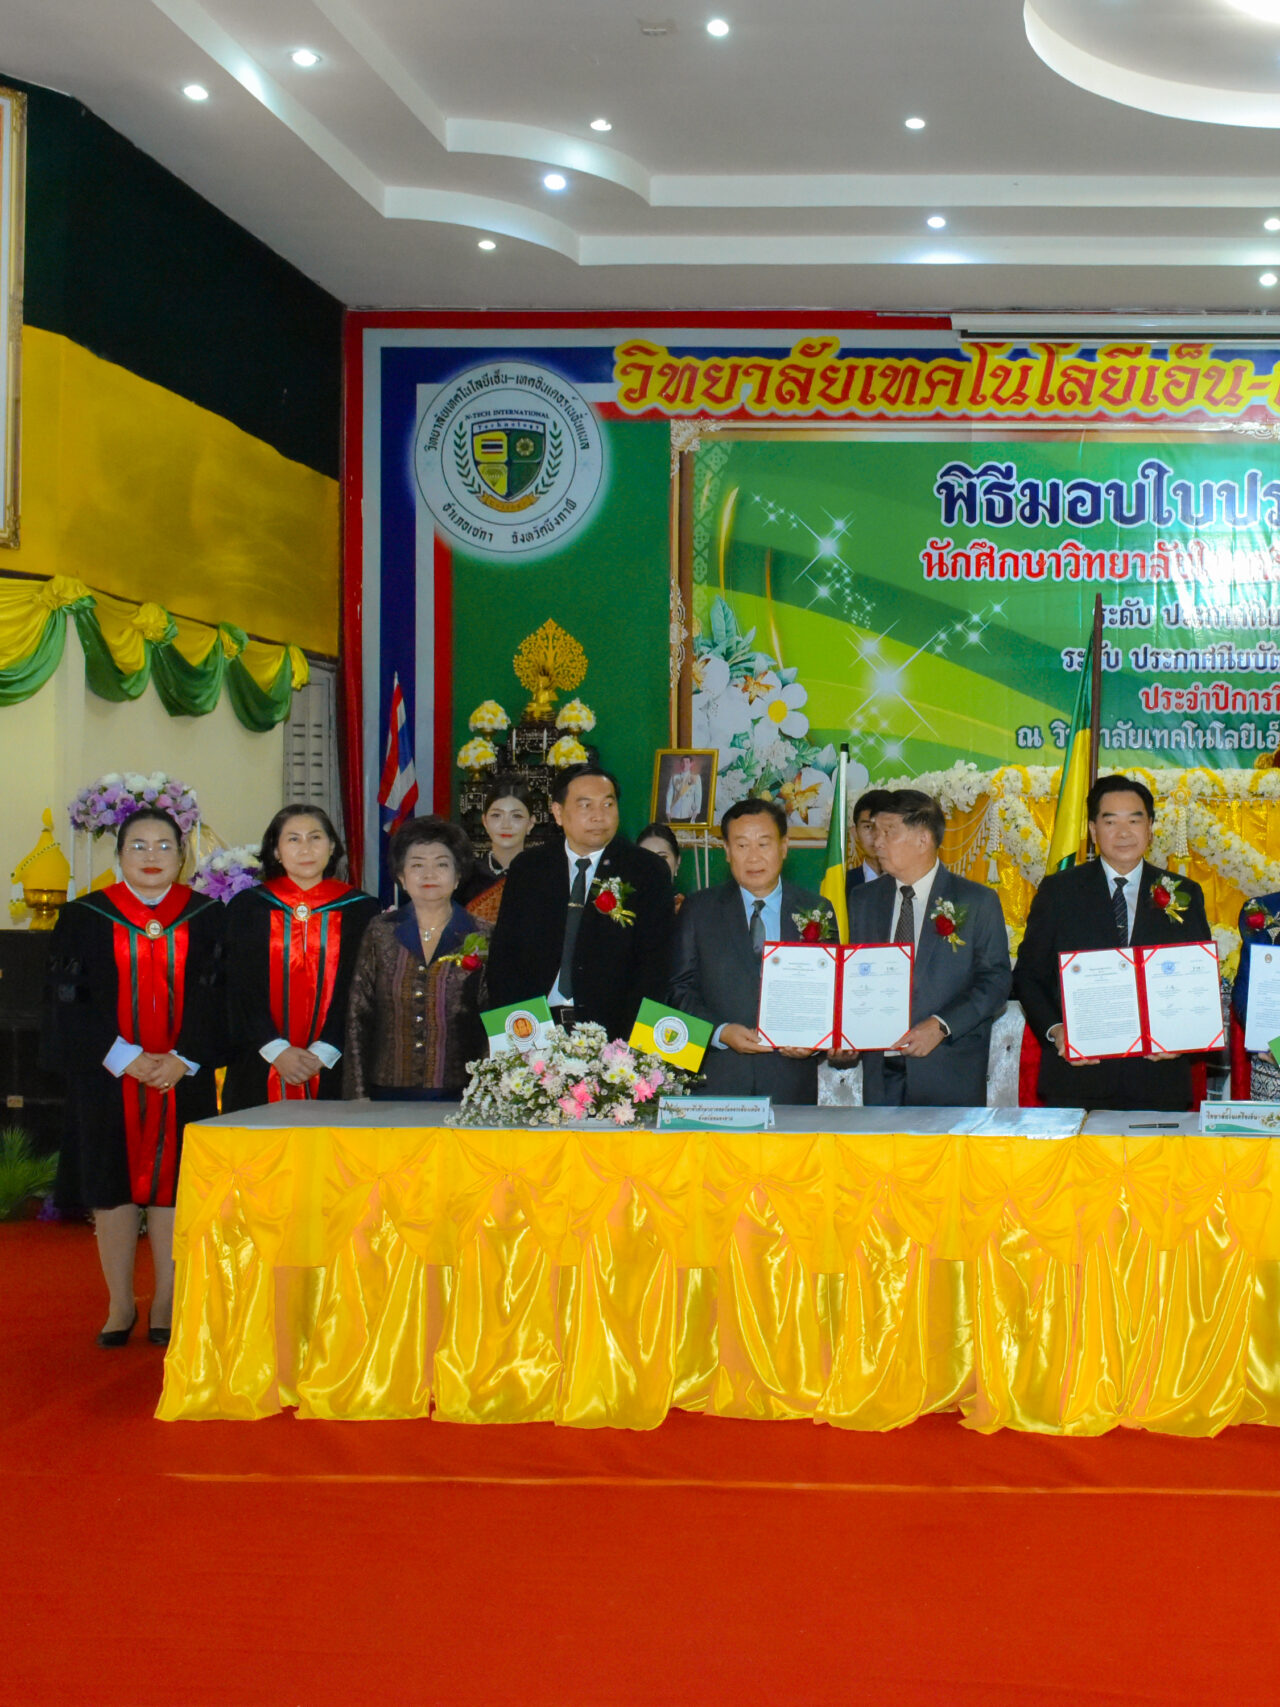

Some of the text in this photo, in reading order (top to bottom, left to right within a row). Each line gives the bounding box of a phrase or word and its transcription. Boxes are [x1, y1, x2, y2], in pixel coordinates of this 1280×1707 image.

[493, 409, 549, 419] INTERNATIONAL
[1064, 642, 1119, 669] ระบ
[1017, 726, 1043, 748] ณ
